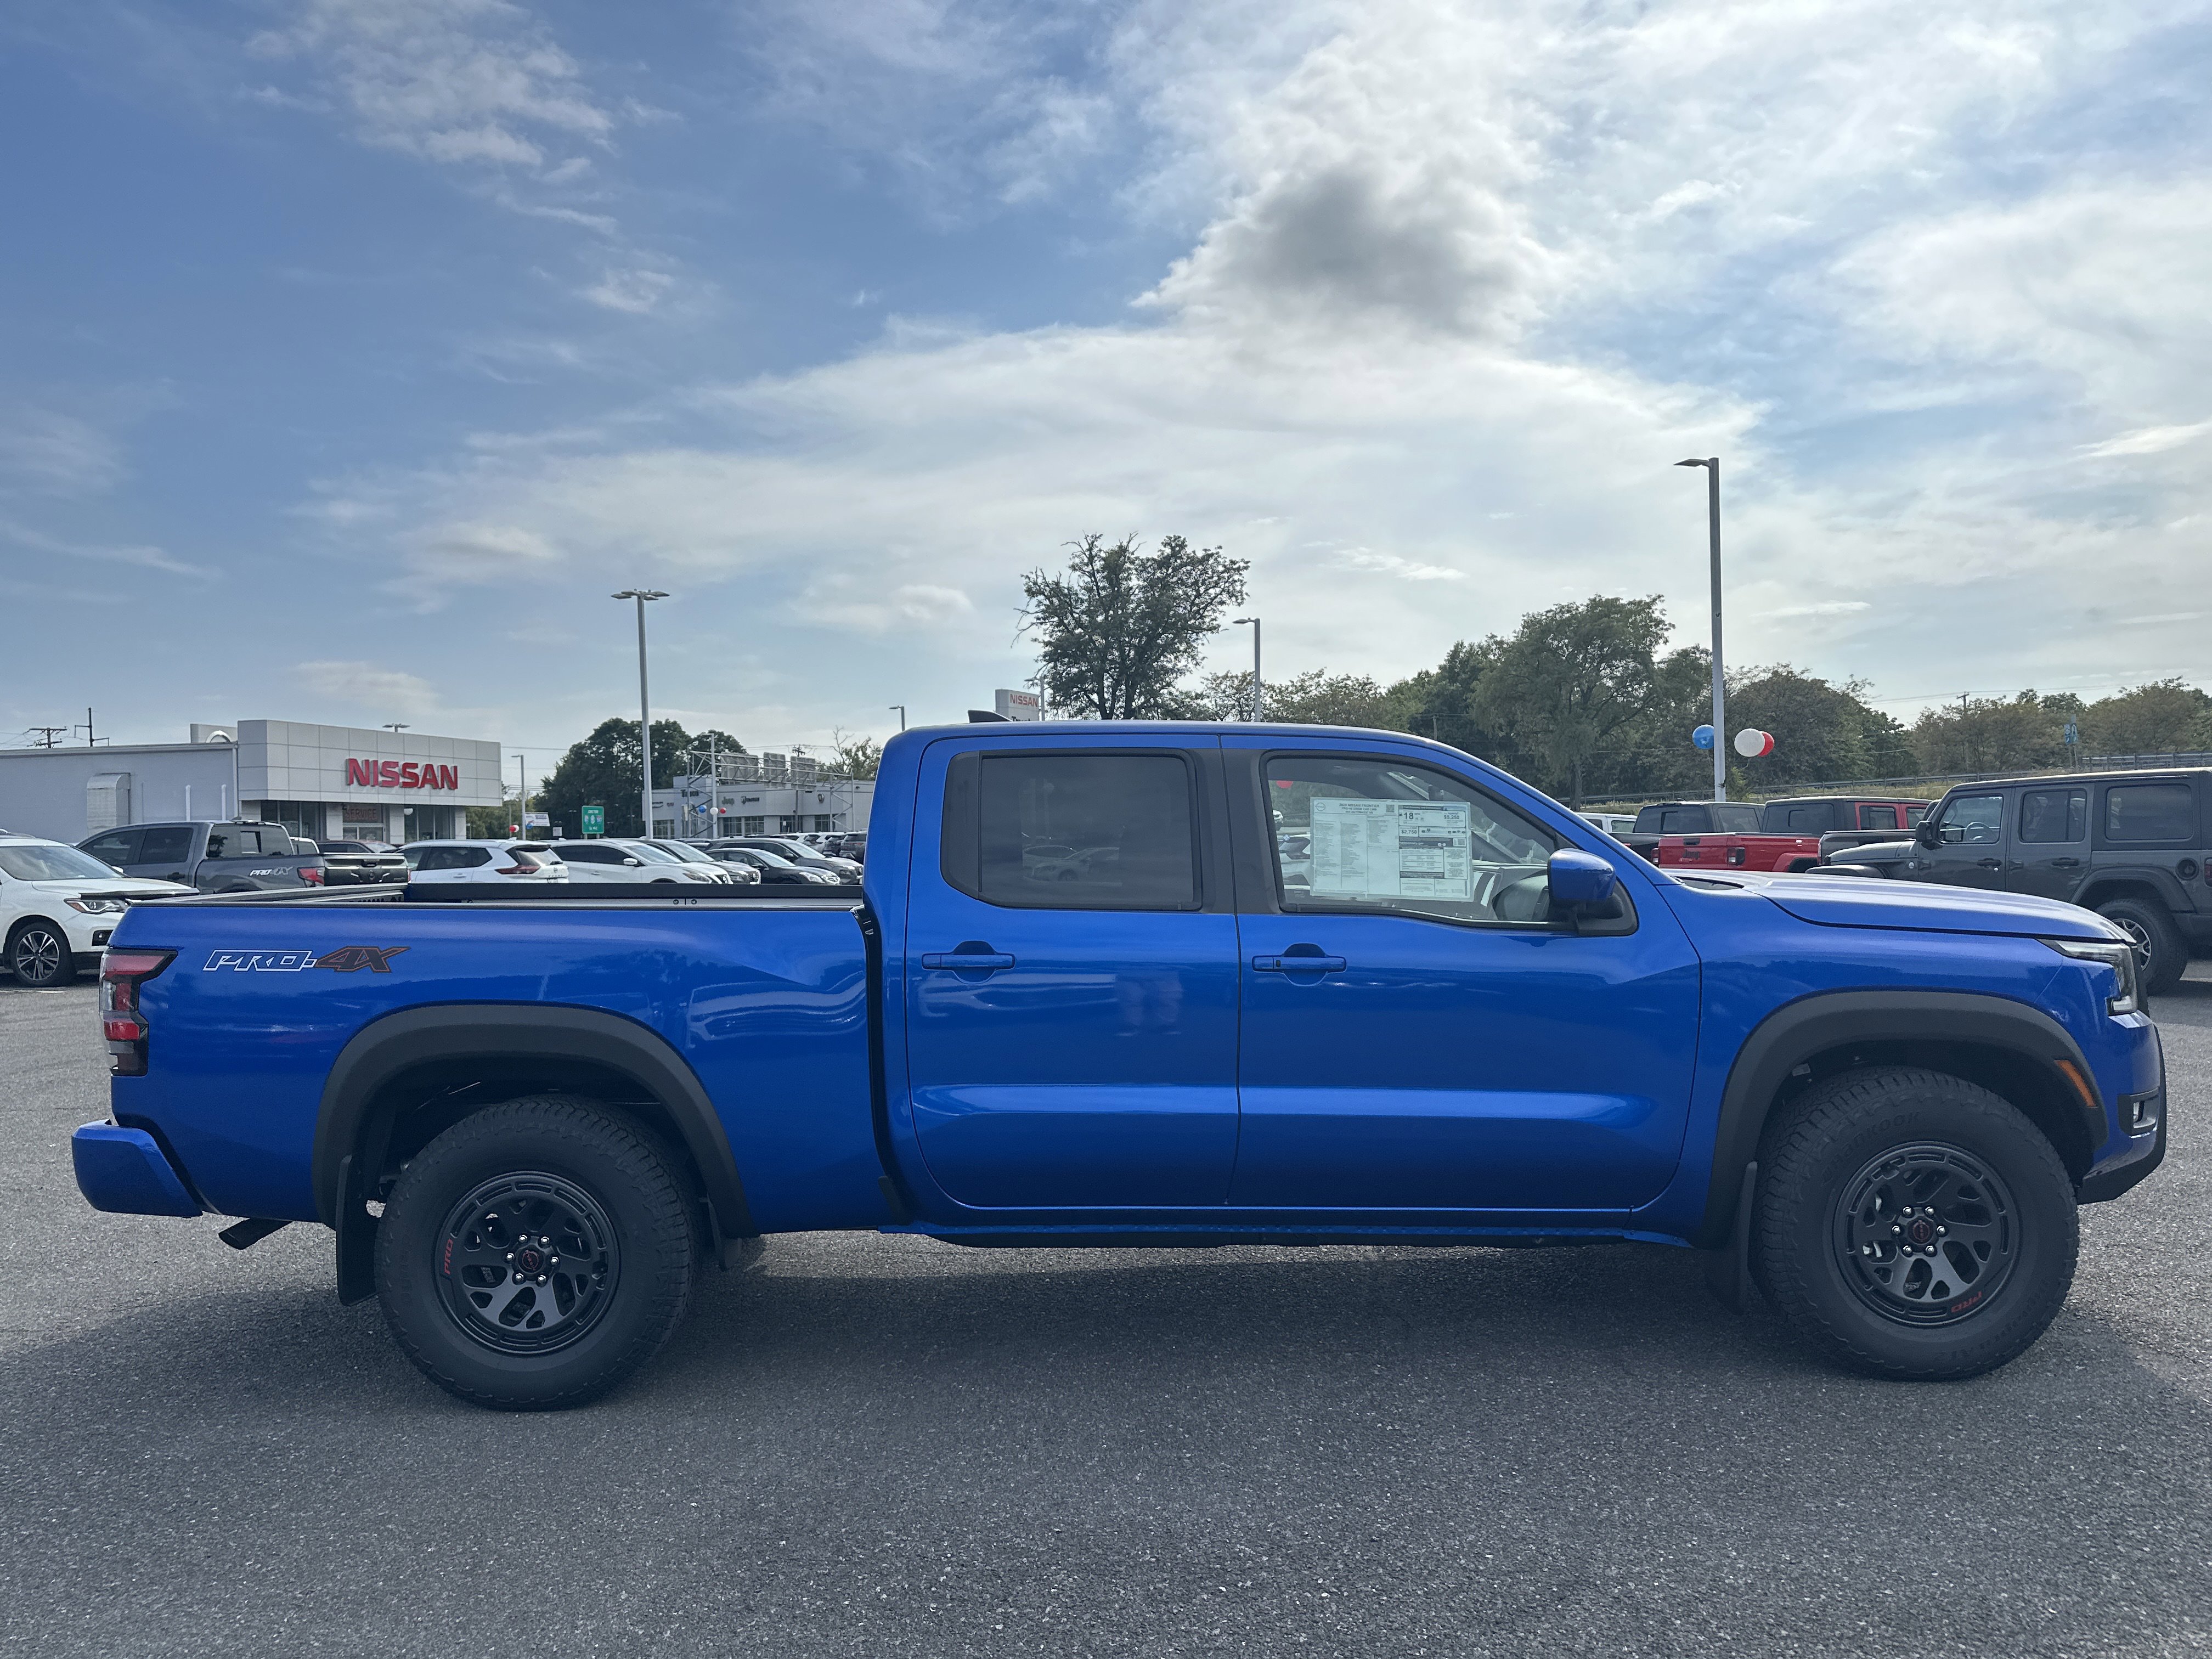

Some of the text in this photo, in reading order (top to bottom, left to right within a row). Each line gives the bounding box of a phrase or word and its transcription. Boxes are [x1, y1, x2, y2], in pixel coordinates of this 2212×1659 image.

[1010, 693, 1039, 707] NISSAN
[346, 758, 458, 790] NISSAN
[346, 808, 377, 820] SERVICE
[444, 1238, 453, 1275] PRO
[1951, 1290, 1982, 1313] PRO
